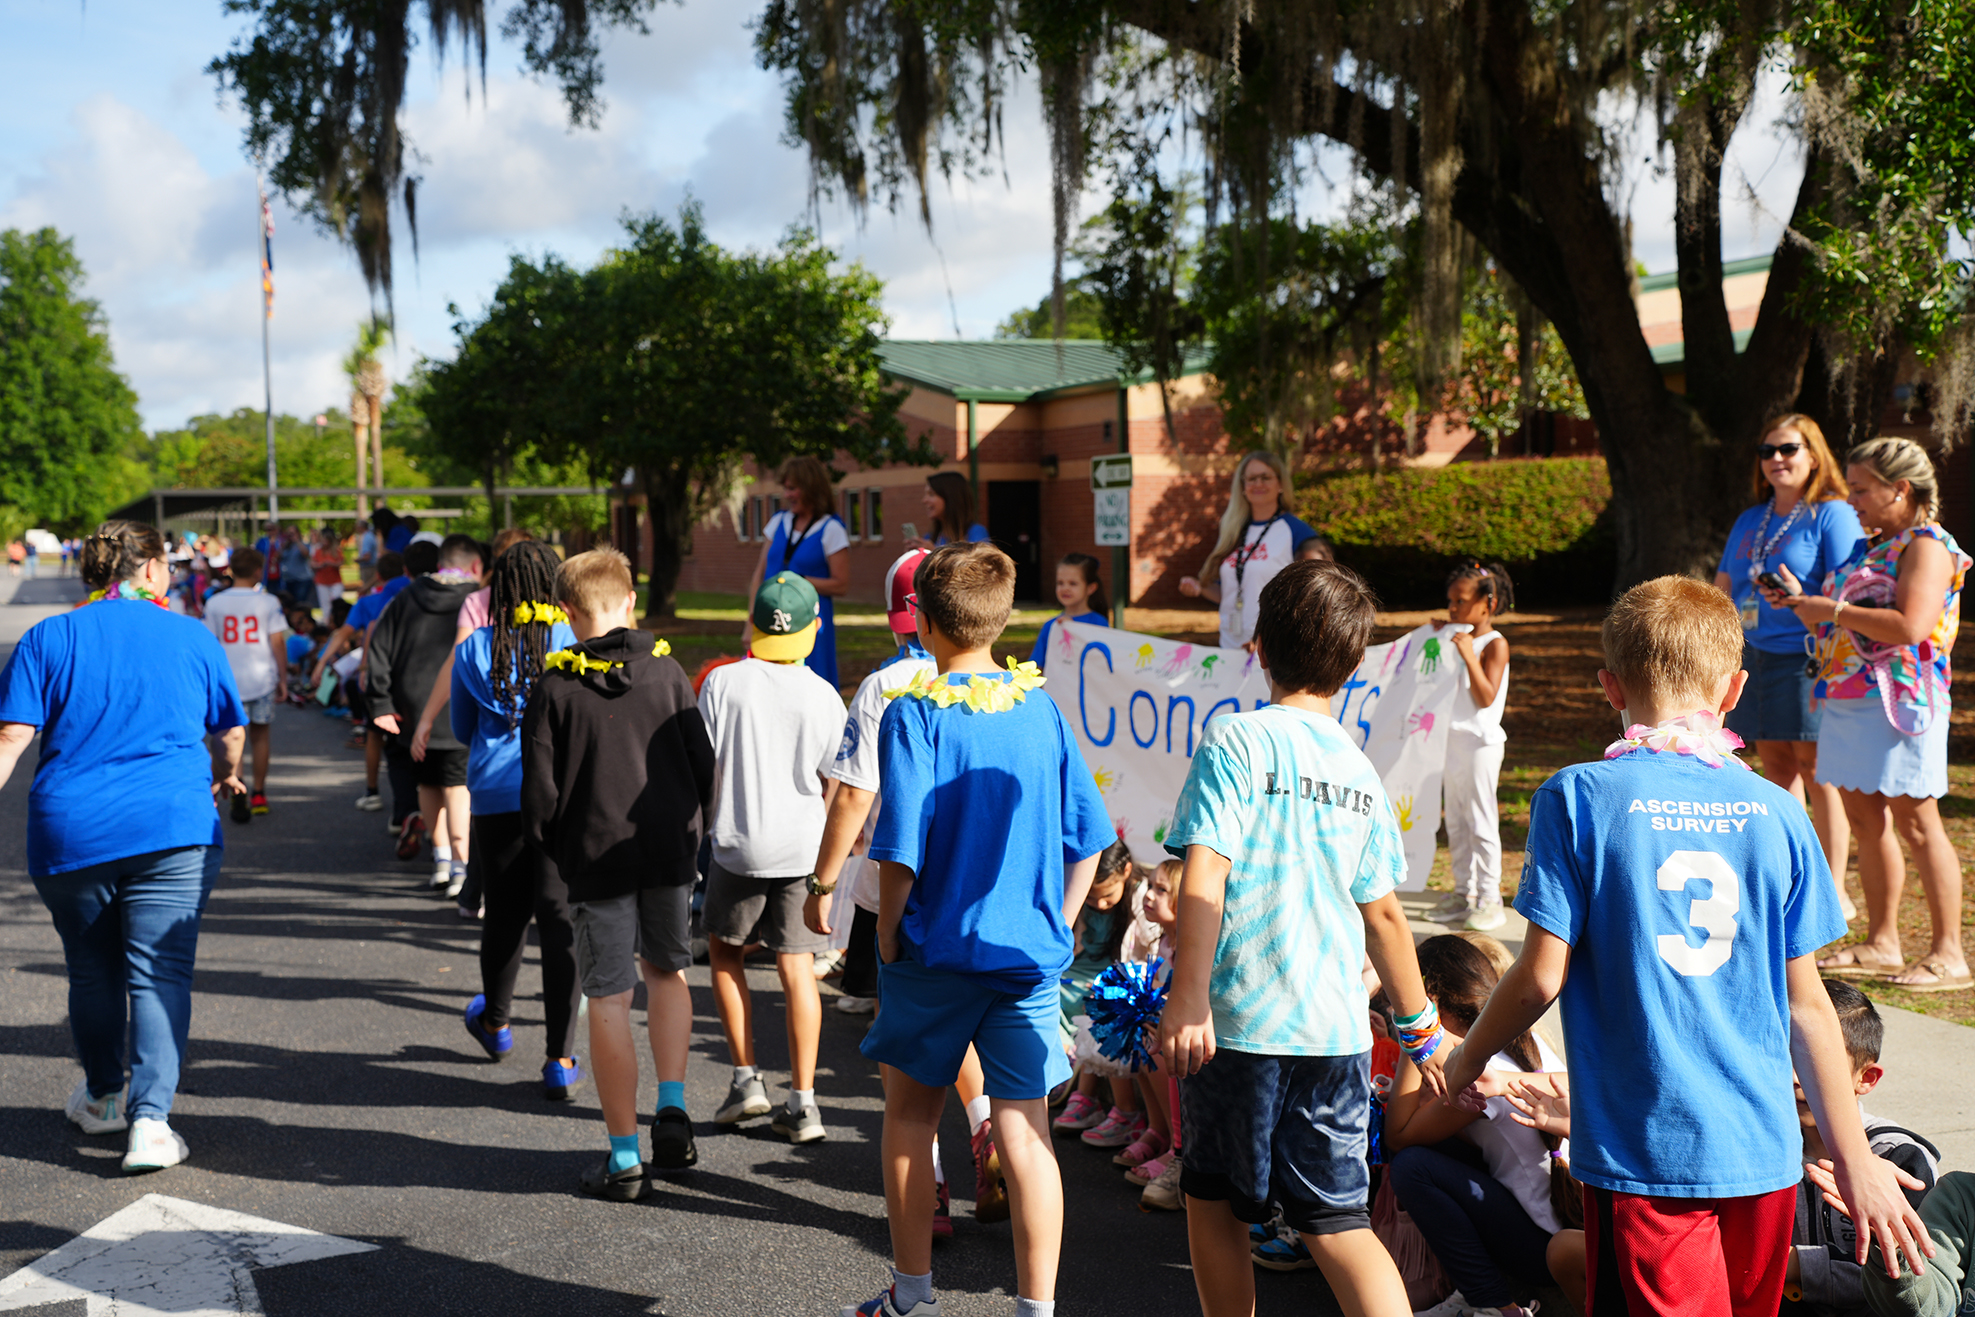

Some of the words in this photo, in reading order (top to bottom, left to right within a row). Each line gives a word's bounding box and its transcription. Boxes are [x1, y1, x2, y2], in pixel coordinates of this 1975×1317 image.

[223, 615, 259, 643] 82
[1079, 641, 1380, 758] Conts
[1299, 776, 1373, 817] DAVIS
[1628, 799, 1769, 817] ASCENSION
[1651, 817, 1748, 834] SURVEY
[1656, 849, 1740, 976] 3
